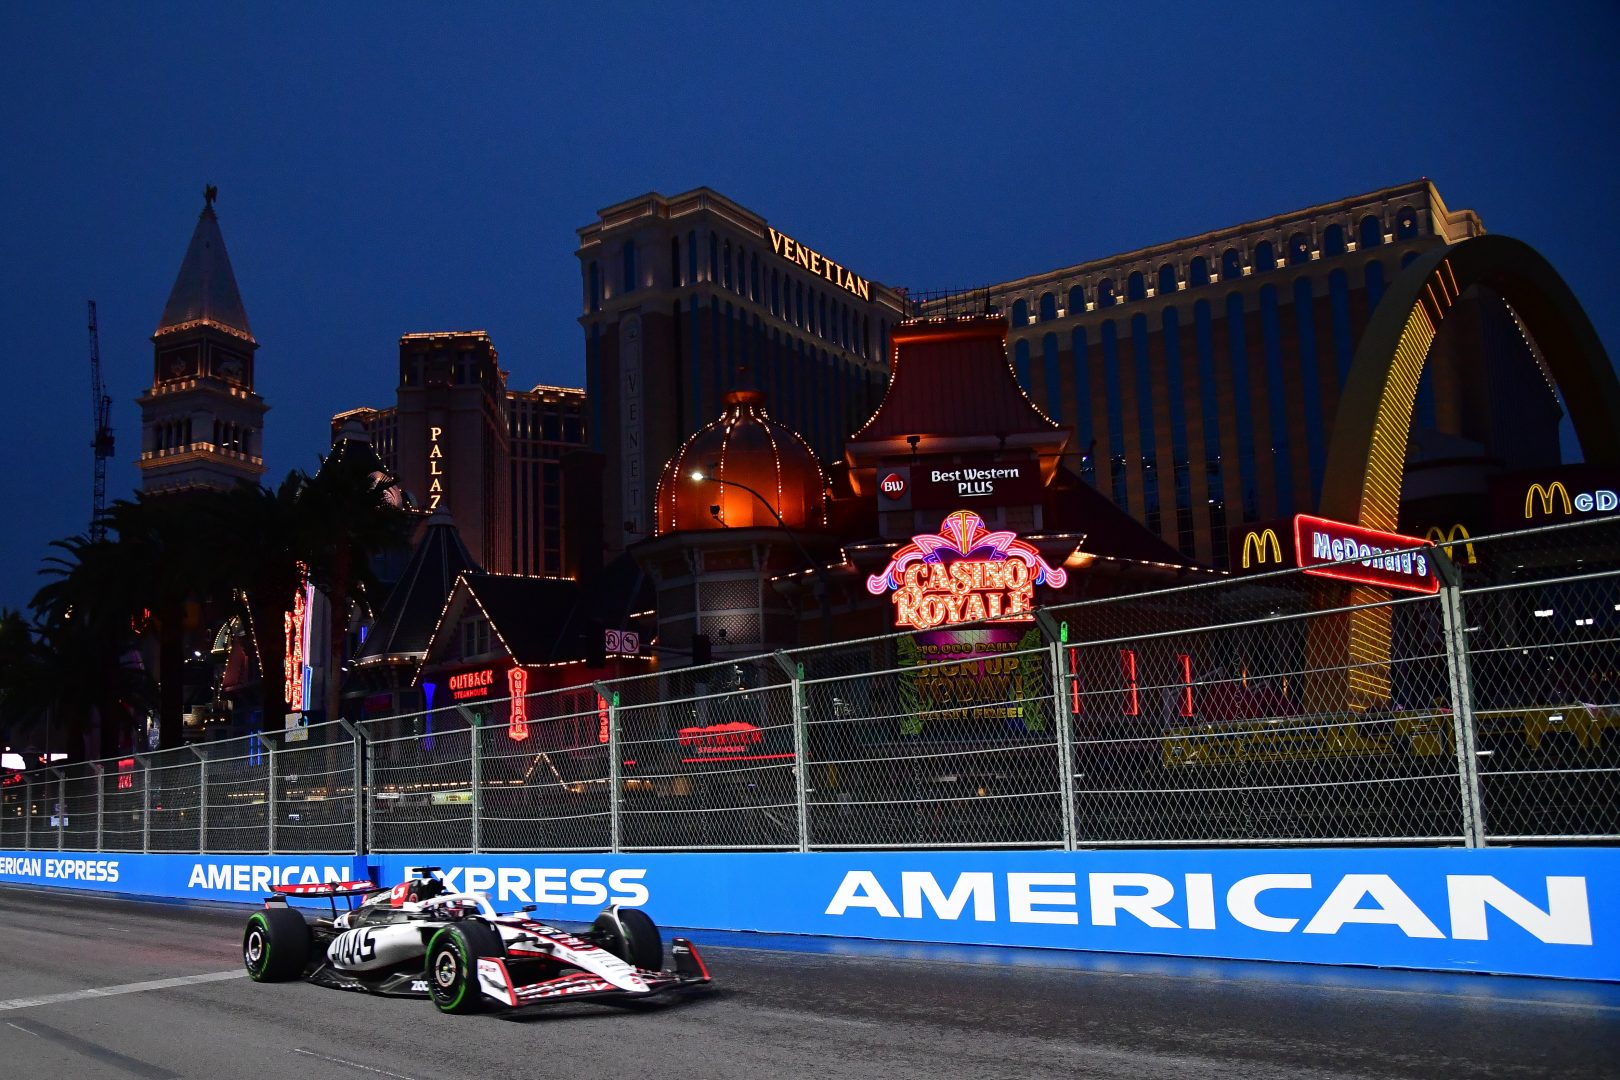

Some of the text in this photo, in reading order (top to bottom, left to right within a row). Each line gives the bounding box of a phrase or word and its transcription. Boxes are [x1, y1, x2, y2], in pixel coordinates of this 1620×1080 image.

[768, 227, 870, 302] VENETIAN
[884, 480, 904, 492] BW
[931, 468, 1019, 482] Best Western
[958, 481, 994, 494] PLUS
[1525, 481, 1620, 518] McD
[1313, 532, 1427, 577] McDonald's
[904, 559, 1028, 595] CASINO
[892, 582, 1036, 630] ROYALE
[975, 641, 1019, 652] DAILY
[449, 670, 493, 690] OUTBACK
[915, 657, 1020, 678] SIGN UP
[454, 687, 488, 699] STEAKHOUSE
[513, 671, 523, 733] OUTBACK
[913, 673, 1024, 705] TODAY!
[45, 859, 119, 883] EXPRESS
[188, 864, 350, 892] AMERICAN
[825, 870, 1593, 945] AMERICAN
